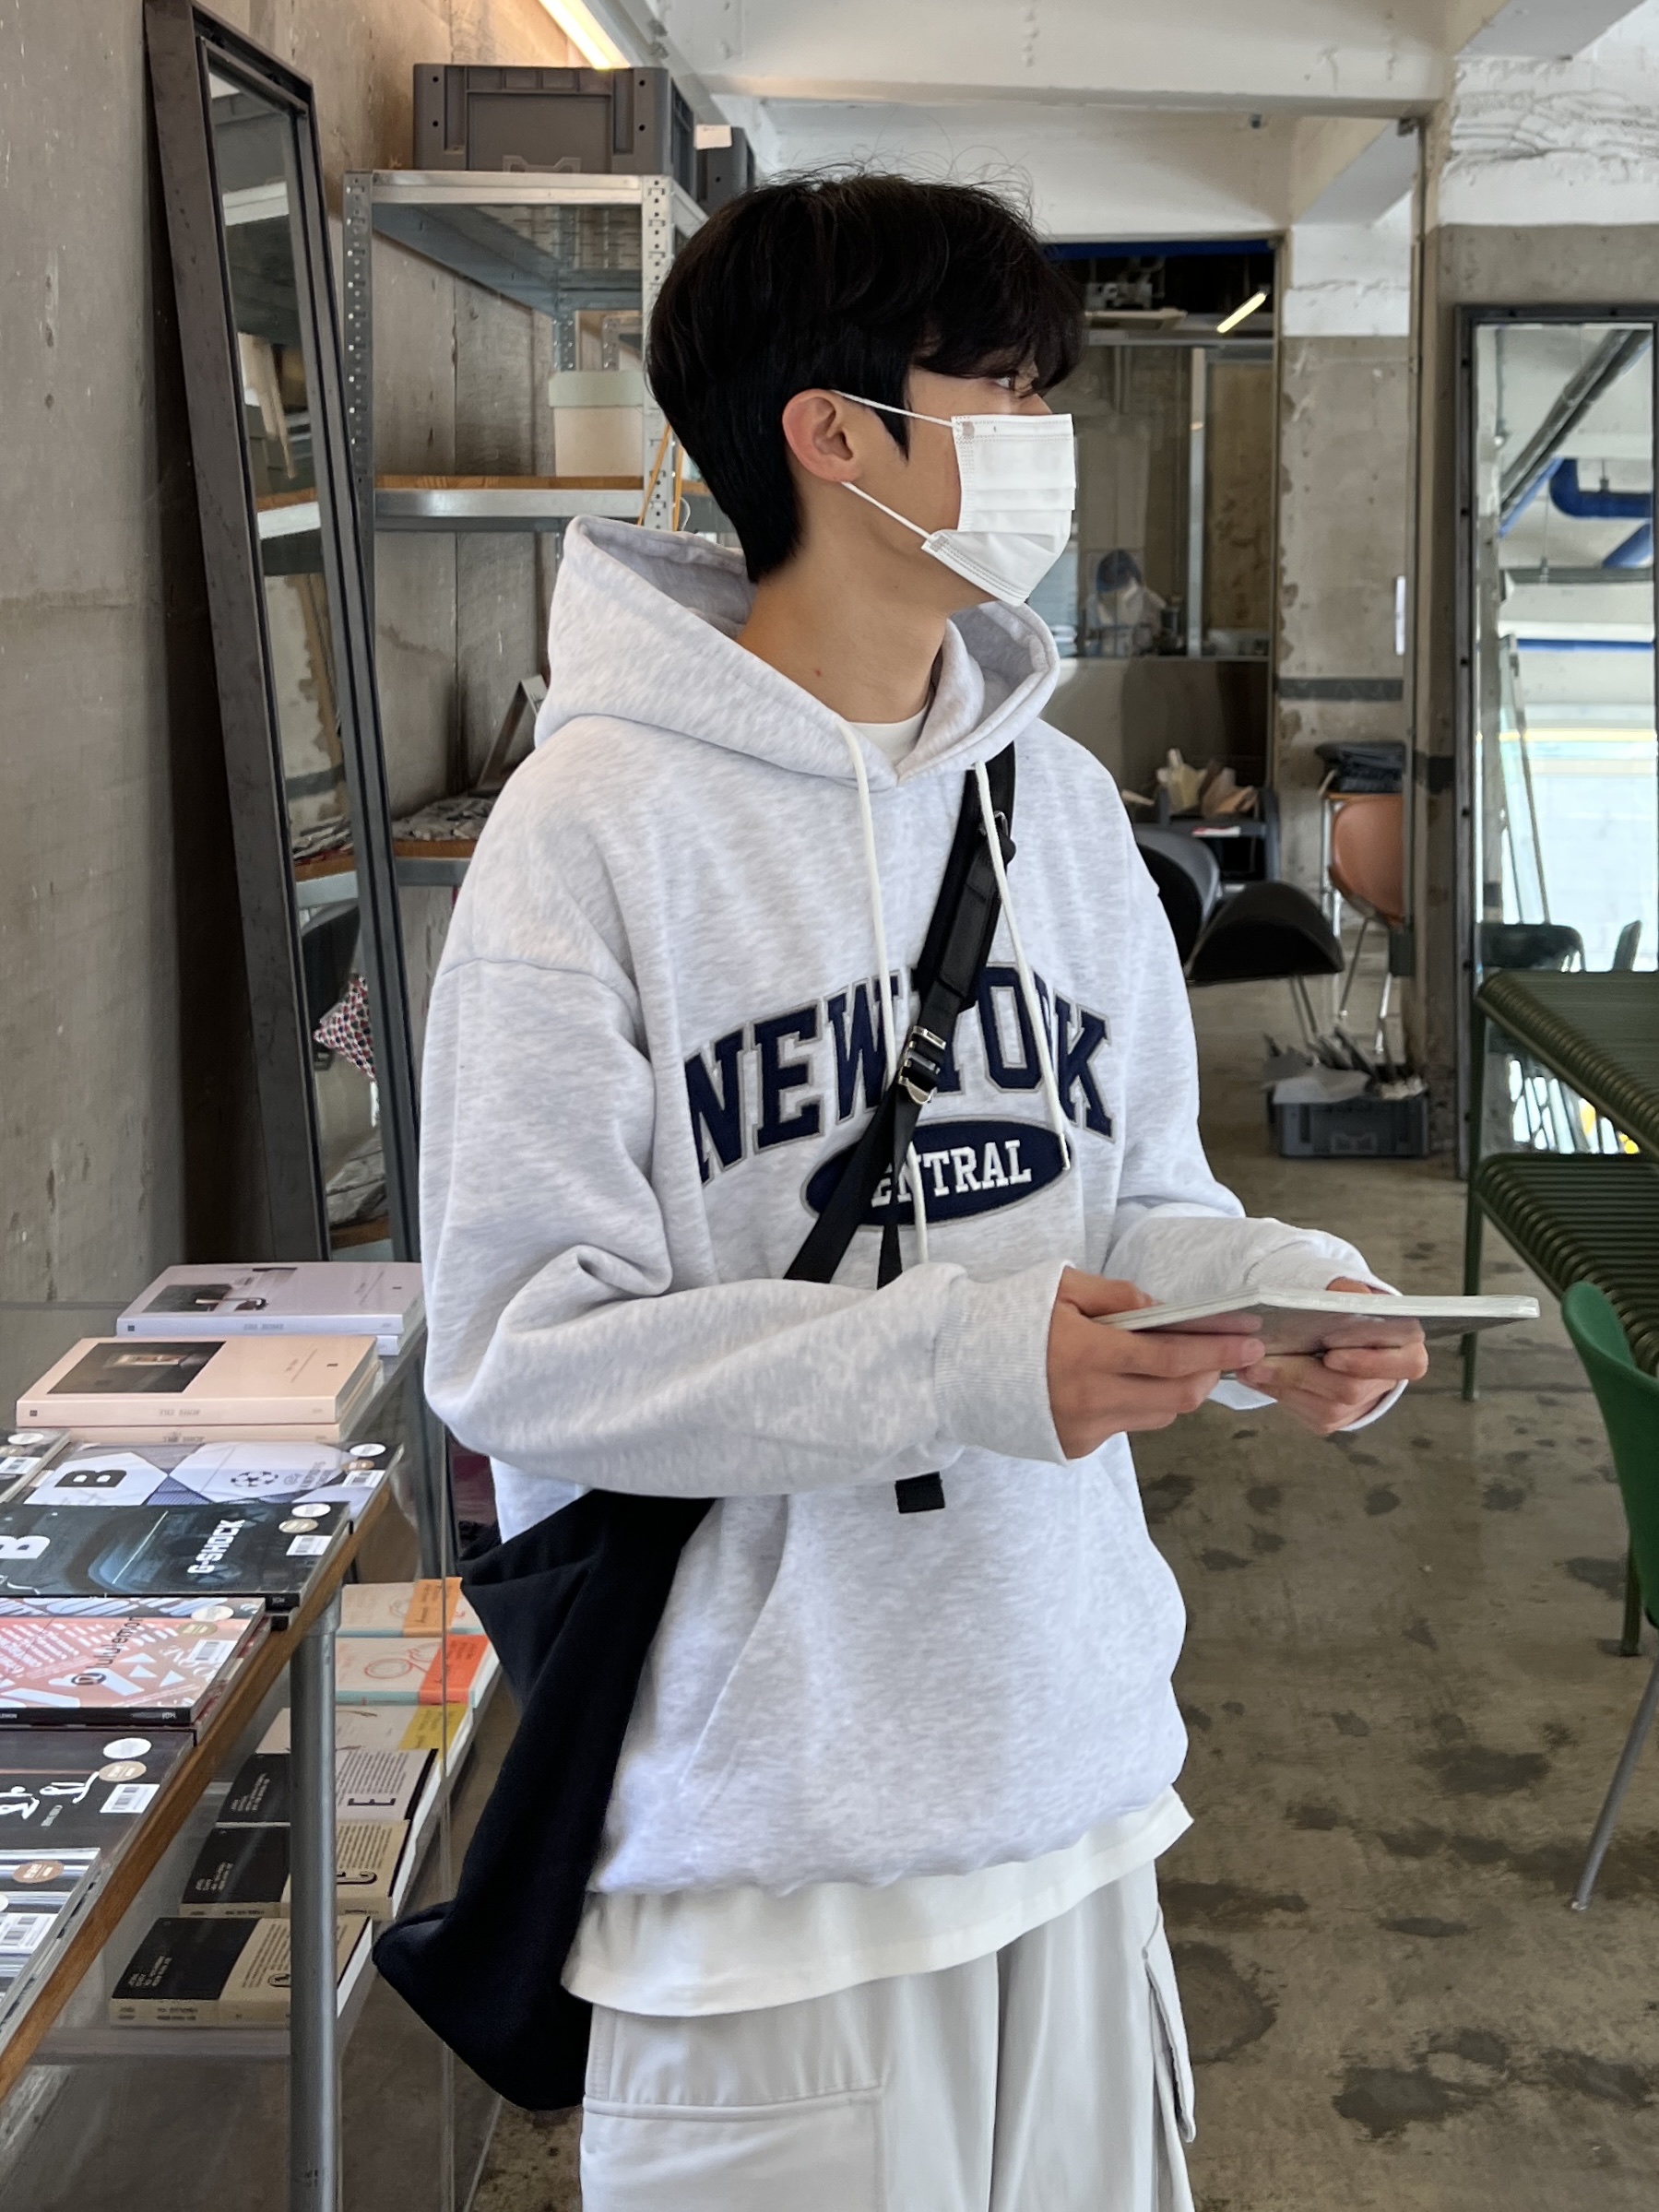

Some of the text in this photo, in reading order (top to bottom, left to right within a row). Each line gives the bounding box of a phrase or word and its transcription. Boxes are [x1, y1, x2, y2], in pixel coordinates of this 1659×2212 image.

[684, 962, 1116, 1186] NEW OK
[870, 1139, 1032, 1208] ENTRAL
[54, 1469, 127, 1488] B
[187, 1519, 245, 1575] G-SHOCK
[85, 1615, 145, 1670] lululemon
